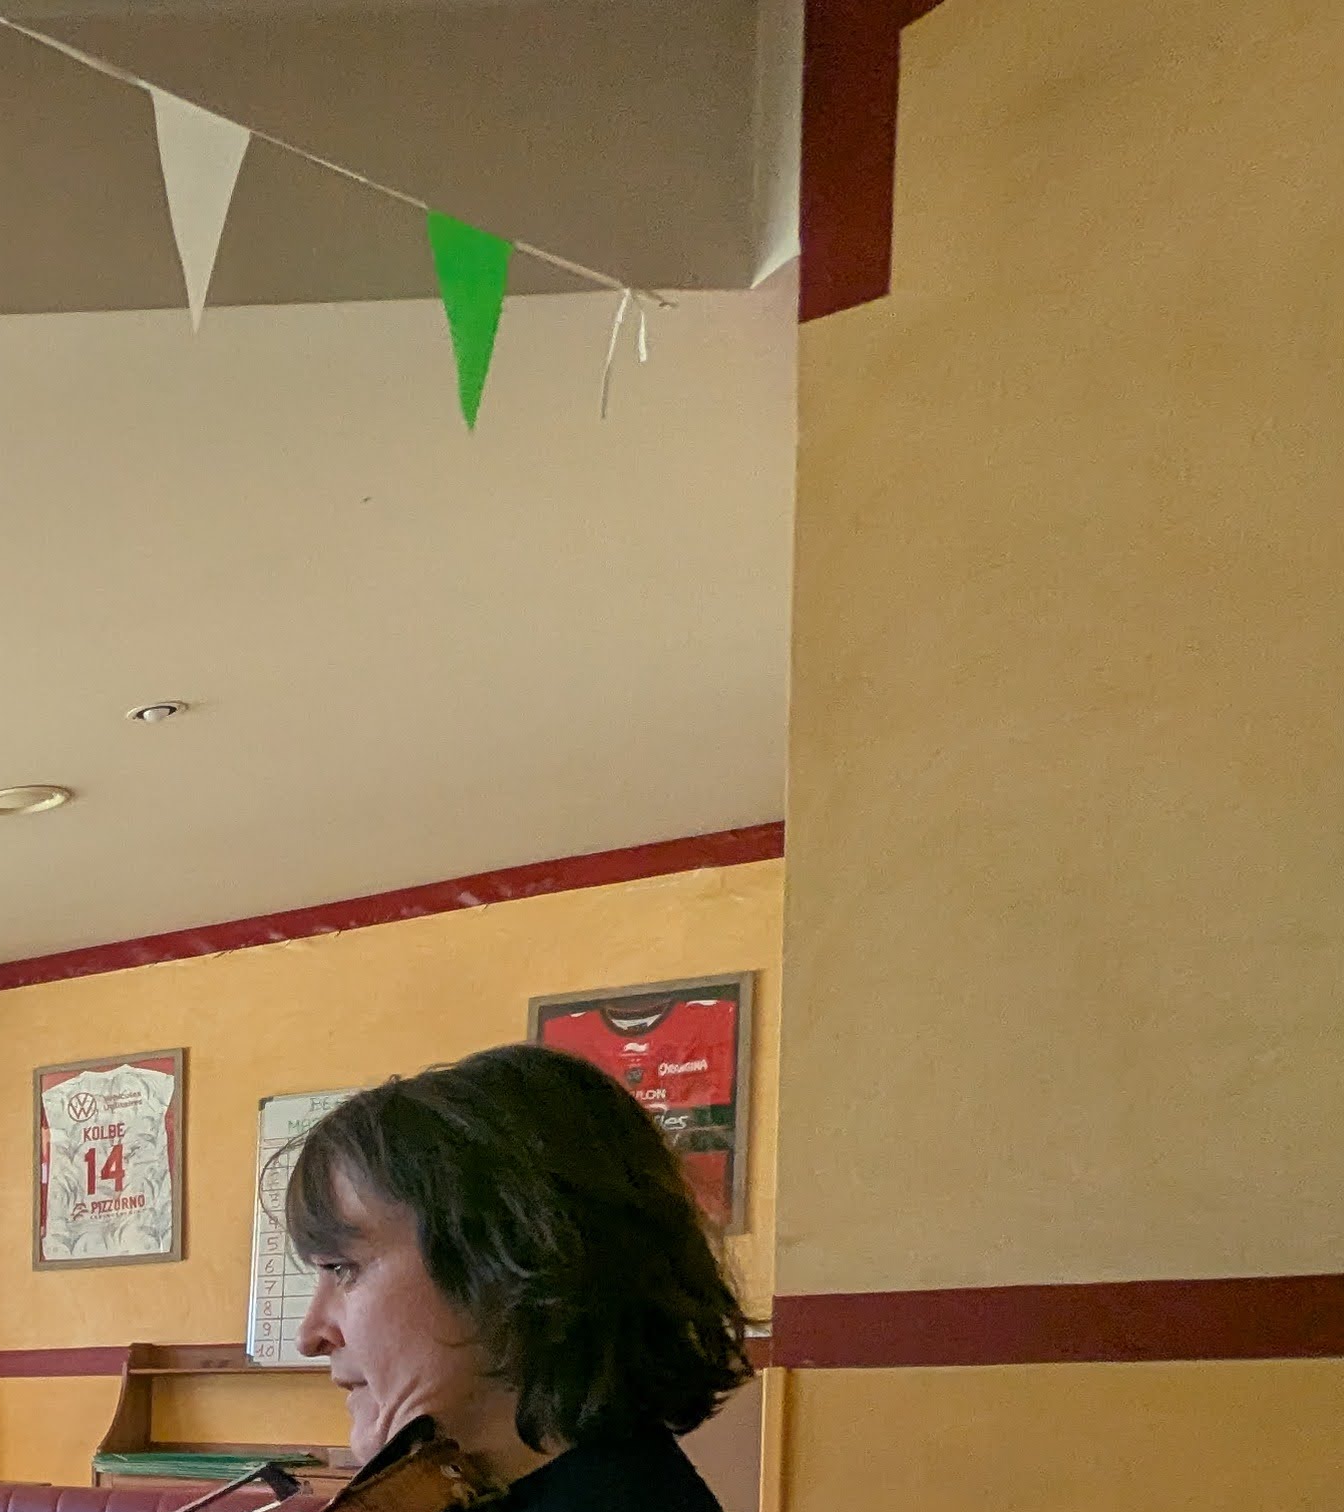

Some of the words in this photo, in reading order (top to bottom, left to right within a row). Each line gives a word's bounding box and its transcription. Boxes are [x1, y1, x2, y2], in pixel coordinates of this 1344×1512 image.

[83, 1123, 125, 1142] KOLBE
[84, 1144, 125, 1195] 14
[91, 1194, 146, 1214] PIZZORNO
[267, 1236, 279, 1251] 5
[264, 1258, 275, 1274] 6
[264, 1280, 278, 1295] 7
[263, 1300, 272, 1317] 8
[262, 1321, 272, 1337] 9
[256, 1343, 275, 1358] 10
